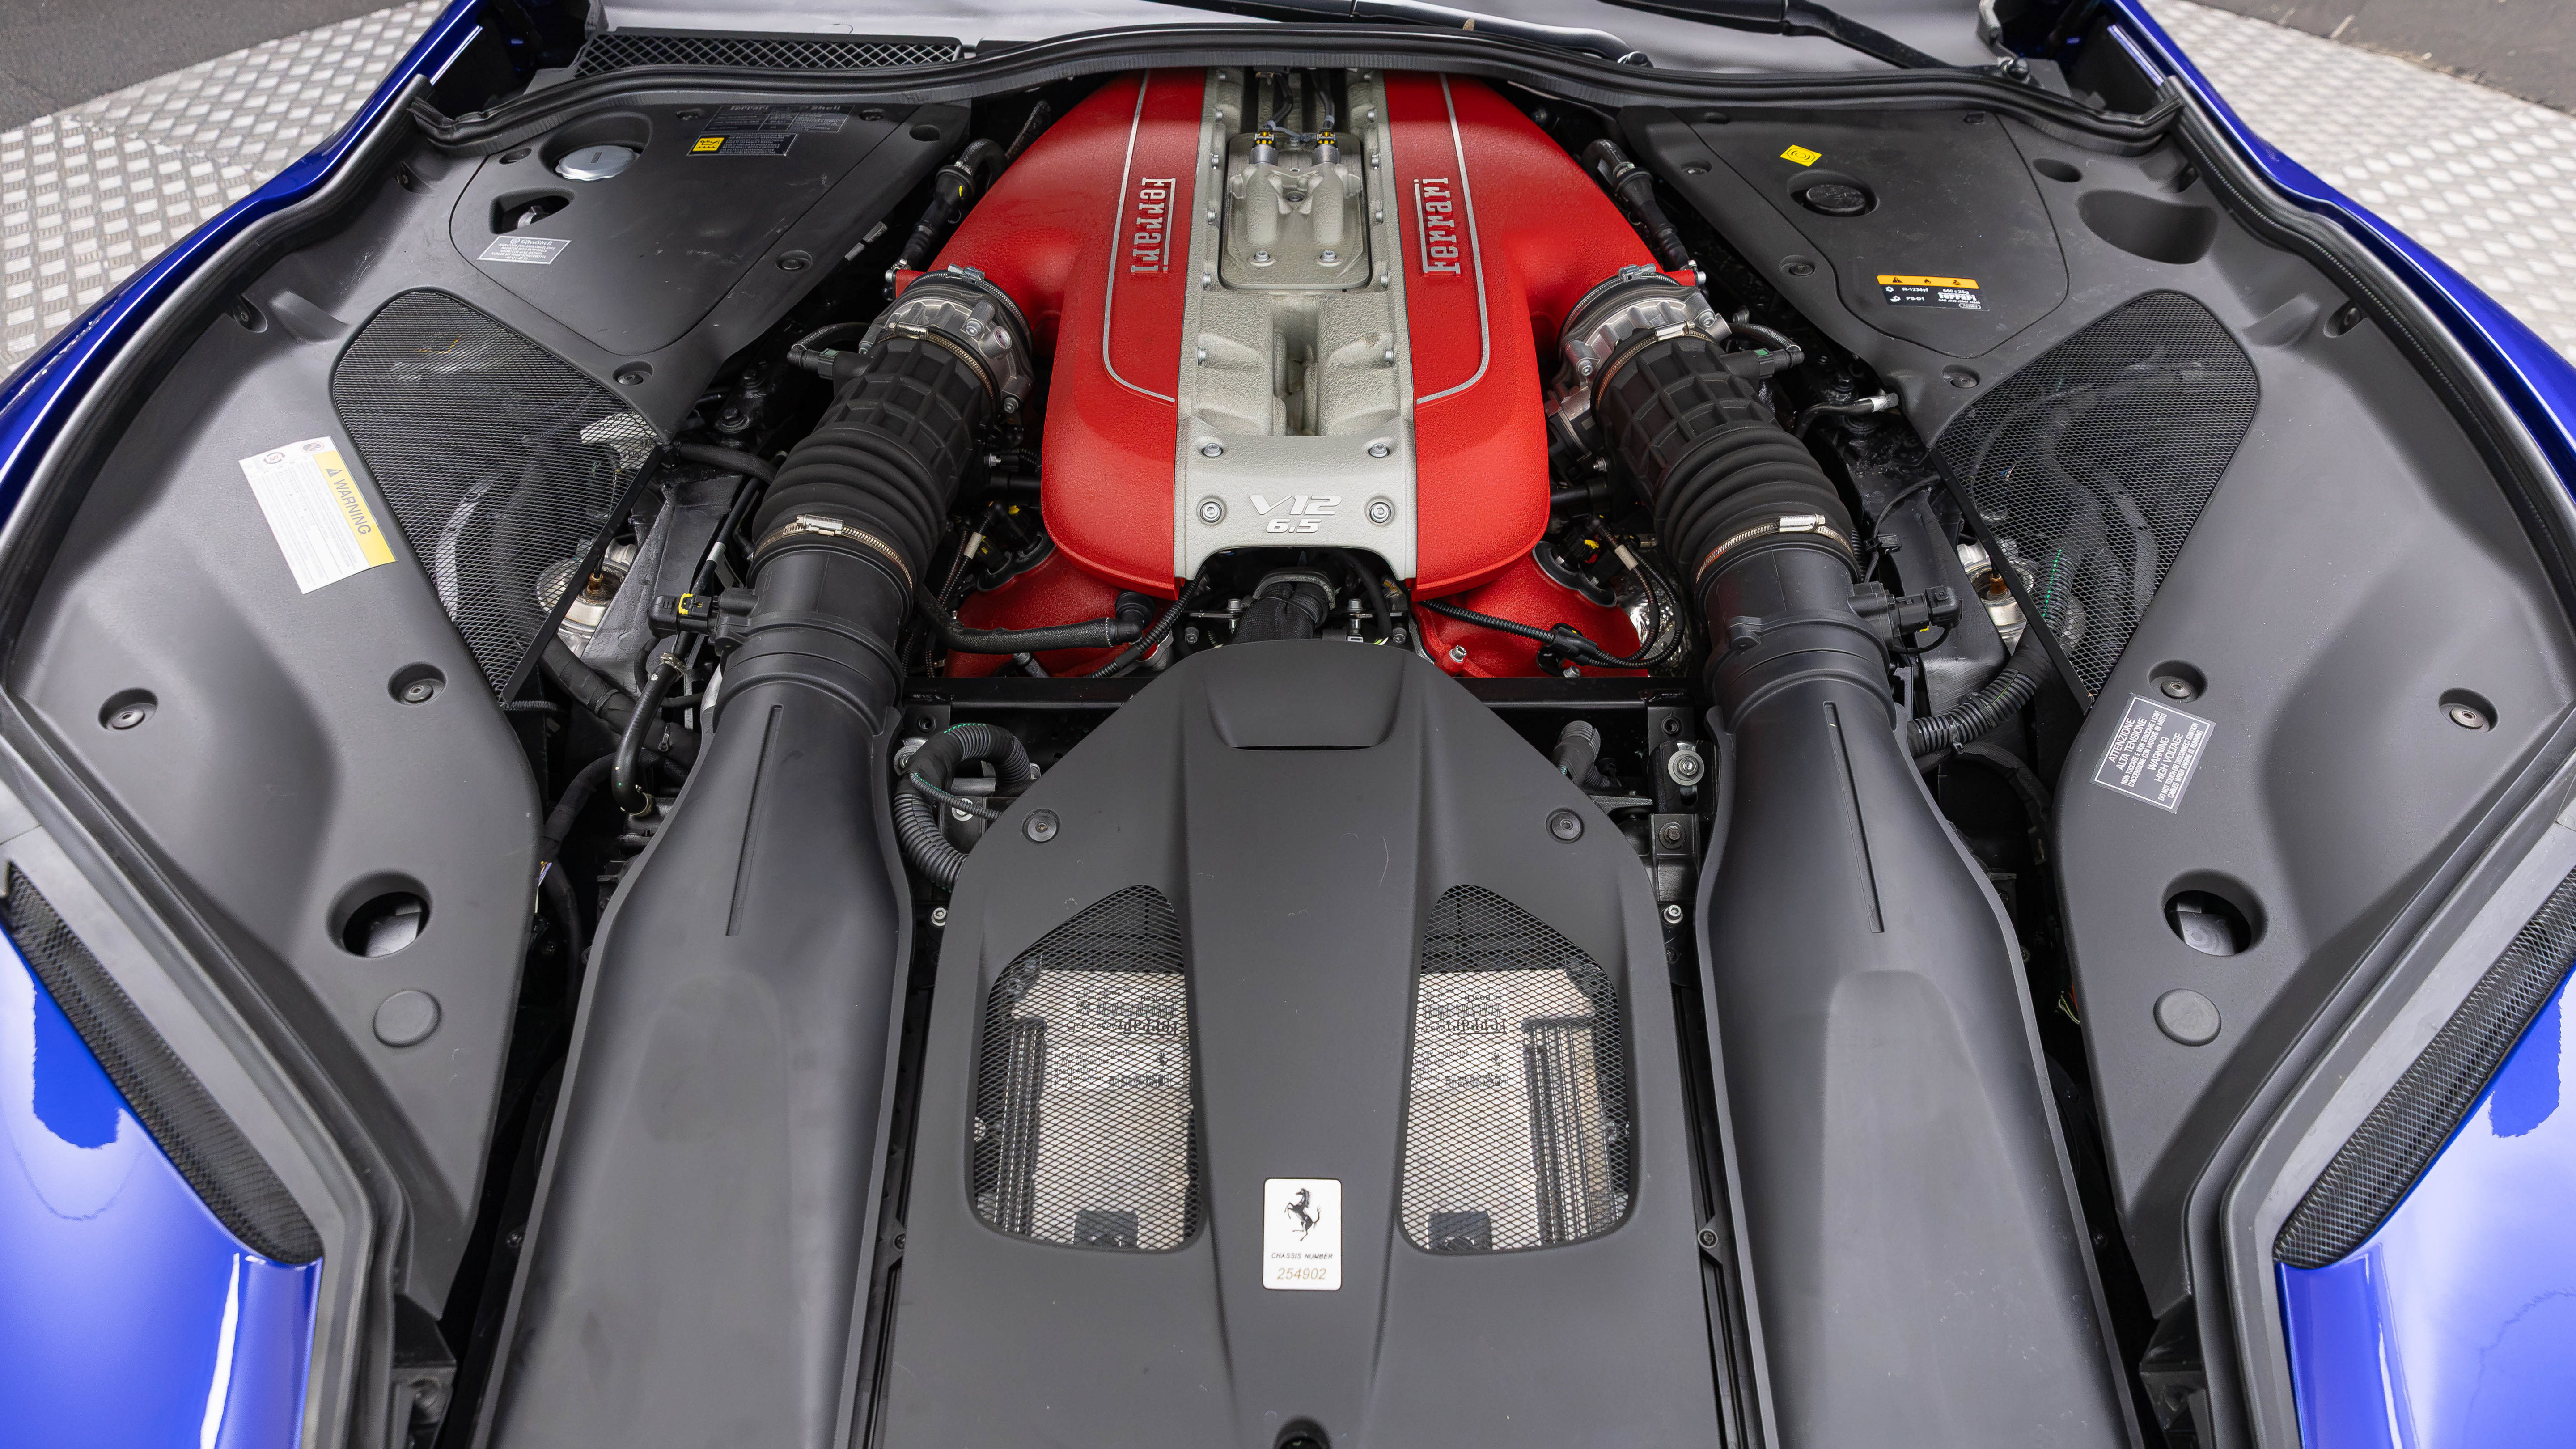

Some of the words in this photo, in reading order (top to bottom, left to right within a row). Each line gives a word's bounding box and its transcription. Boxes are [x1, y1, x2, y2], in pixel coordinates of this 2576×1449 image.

[1131, 177, 1176, 273] Ferrari
[1414, 178, 1461, 274] Ferrari
[334, 479, 371, 535] WARNING
[1249, 495, 1342, 515] V12
[1266, 518, 1322, 533] 6.5
[2108, 718, 2135, 763] ATTENZIONE
[2116, 754, 2131, 771] ALTA
[2124, 717, 2147, 752] TENSIONE
[2120, 774, 2130, 785] NON
[2125, 756, 2139, 774] TOCCARE
[2136, 742, 2145, 752] NON
[2141, 722, 2155, 743] STACCARE
[2152, 710, 2161, 720] CAVI
[2127, 757, 2146, 787] D'ACCENSIONE
[2142, 747, 2151, 758] CON
[2148, 730, 2159, 748] MOTORE
[2158, 713, 2167, 726] MOTO
[2186, 722, 2199, 740] IGNITION
[2148, 736, 2169, 770] WARNING
[2154, 763, 2169, 783] HIGH
[2163, 733, 2183, 762] VOLTAGE
[2168, 782, 2179, 798] CABLES
[2174, 769, 2185, 782] WHEN
[2181, 754, 2192, 769] ENGINE
[2190, 730, 2203, 749] RUNNING
[2174, 739, 2190, 764] DISCONNECT
[2158, 793, 2166, 801] DO
[2161, 784, 2169, 793] NOT
[2165, 771, 2176, 786] TOUCH
[1277, 1268, 1327, 1280] 254902
